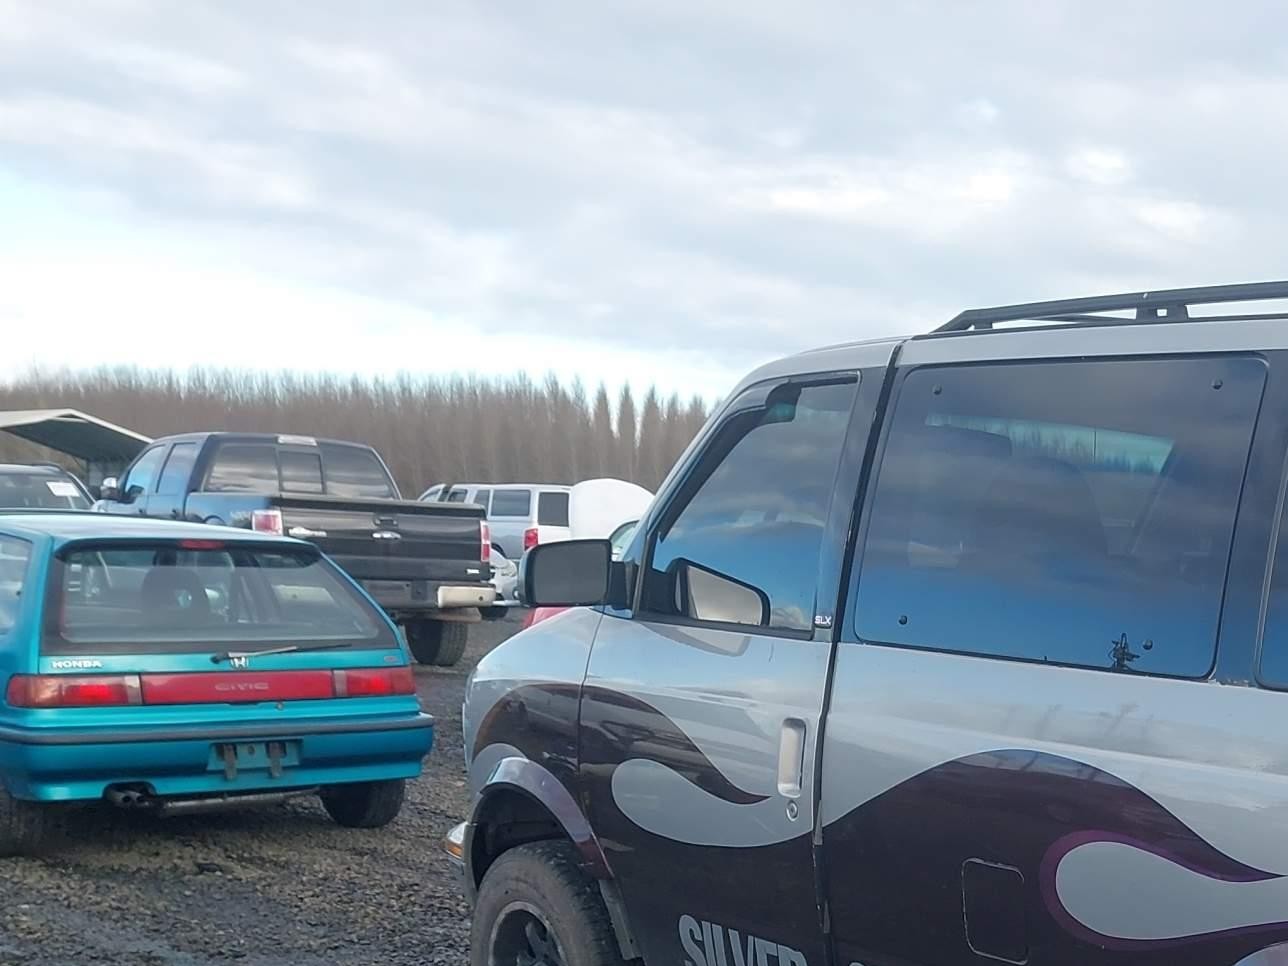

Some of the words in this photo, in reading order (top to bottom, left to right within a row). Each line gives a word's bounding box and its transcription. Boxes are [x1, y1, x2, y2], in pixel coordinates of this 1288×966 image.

[814, 615, 832, 625] SLX
[52, 660, 103, 669] HONDA
[214, 682, 270, 691] CIVIC
